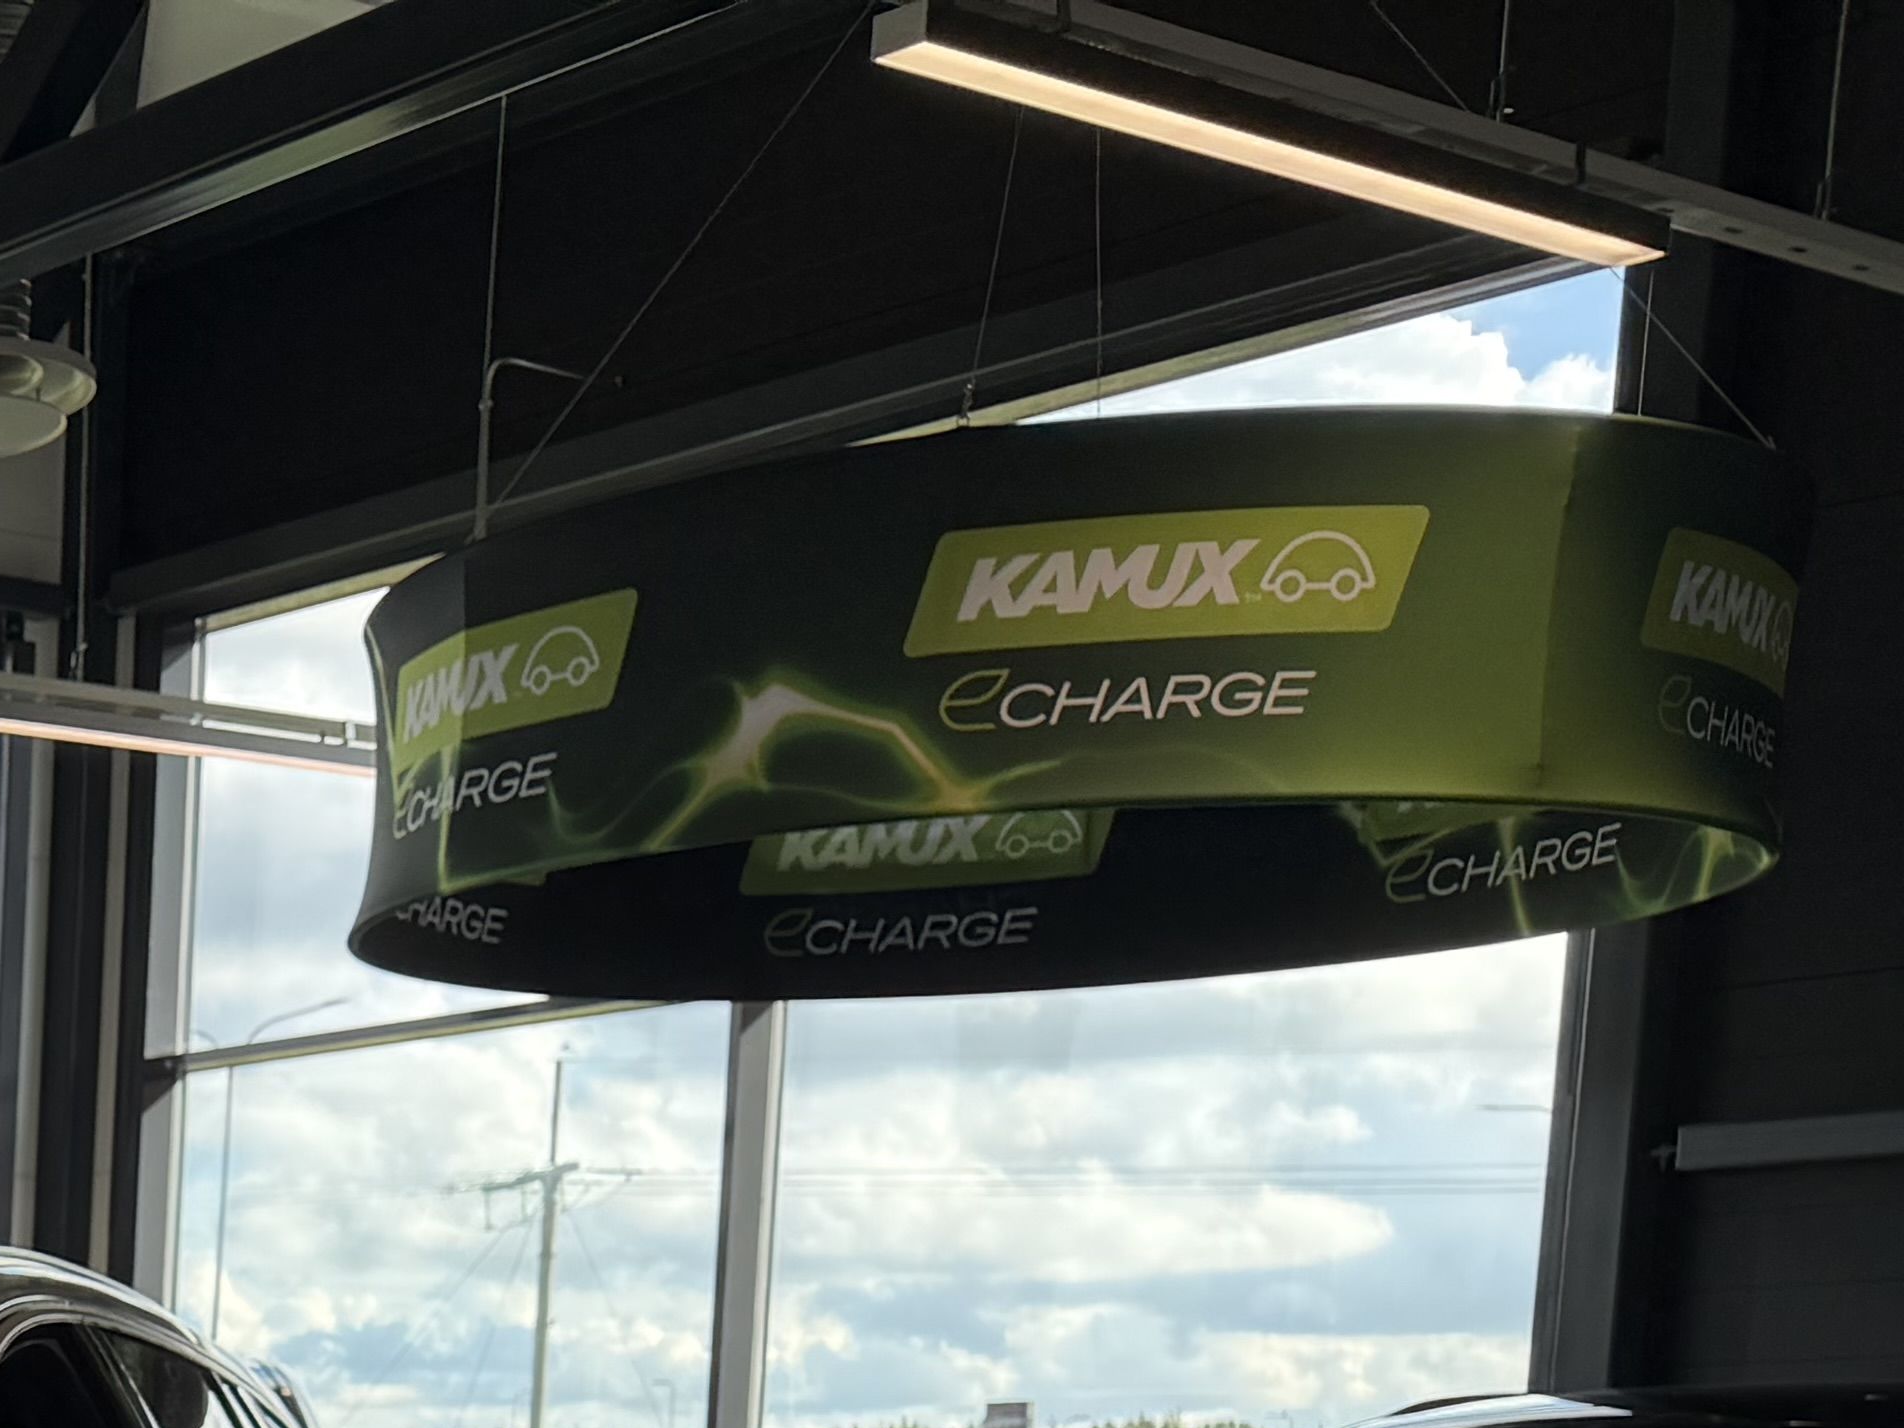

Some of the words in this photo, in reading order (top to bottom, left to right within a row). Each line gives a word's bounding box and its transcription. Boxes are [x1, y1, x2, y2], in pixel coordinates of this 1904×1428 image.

[957, 537, 1261, 622] KAMUX
[1670, 559, 1776, 653] KAMUX
[402, 642, 520, 743] KAMUX
[776, 814, 993, 872] KAMUX
